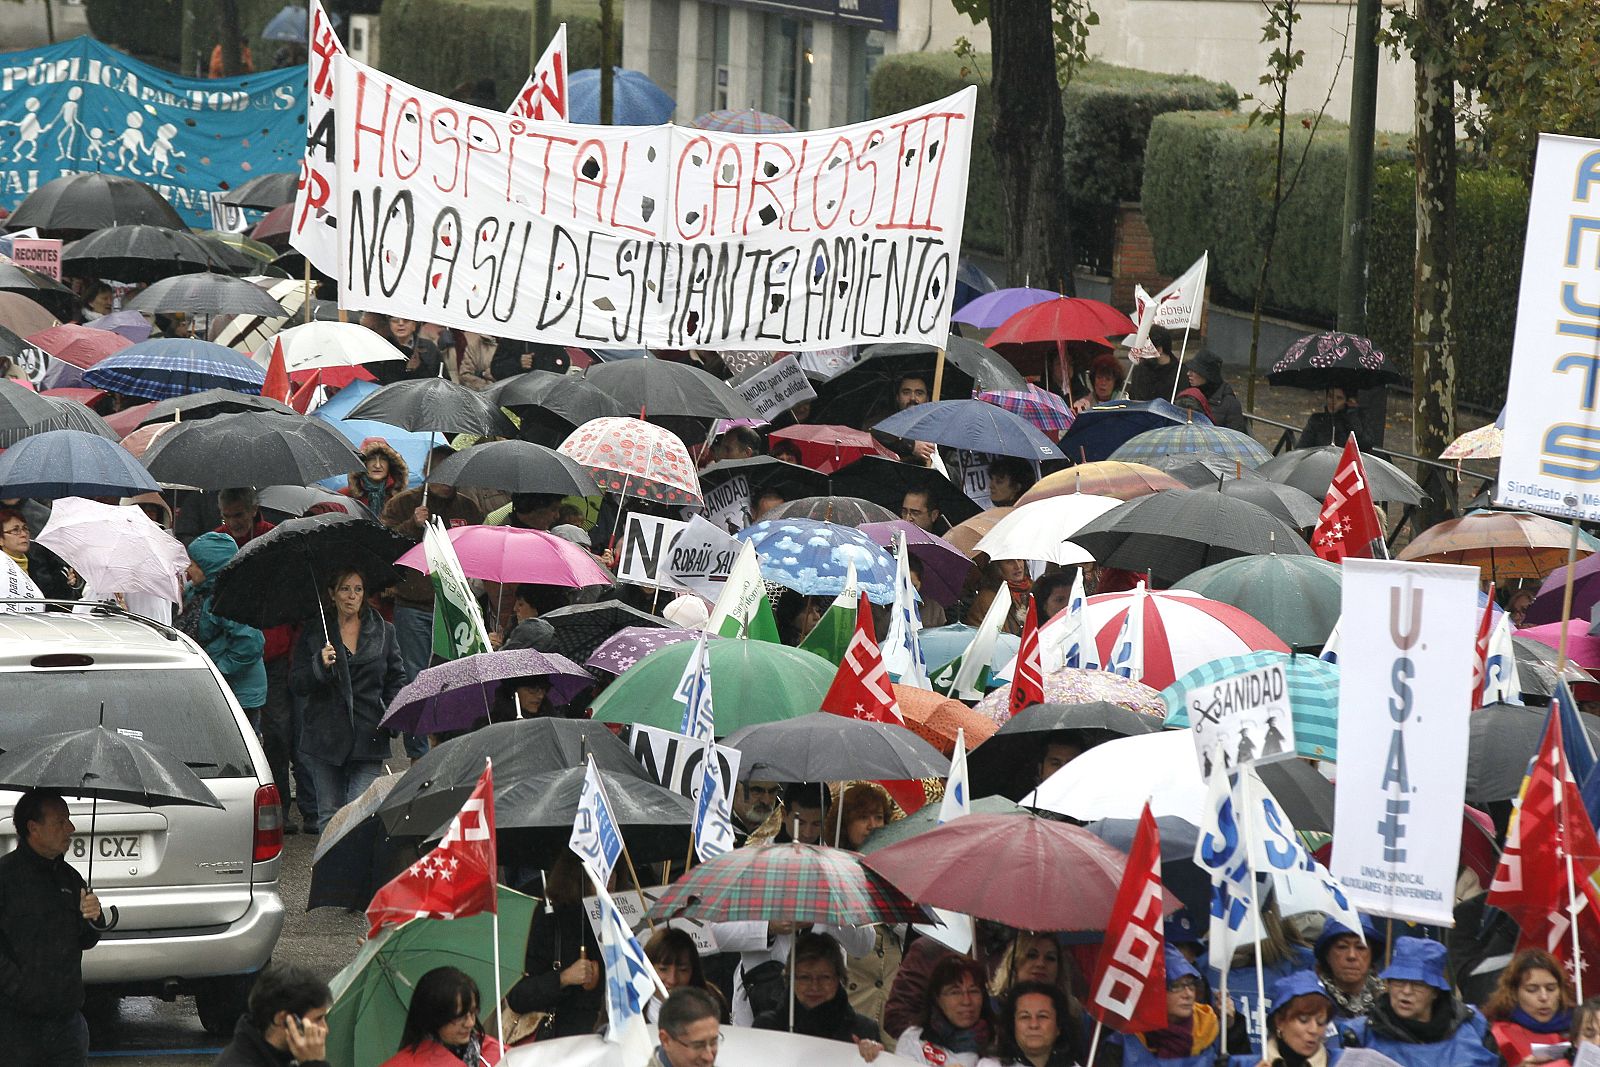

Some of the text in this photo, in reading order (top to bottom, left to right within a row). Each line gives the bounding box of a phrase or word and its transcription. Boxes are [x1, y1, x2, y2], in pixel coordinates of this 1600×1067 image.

[675, 130, 884, 240] CARLOS
[876, 112, 965, 232] III
[15, 248, 58, 262] RECORTES
[349, 186, 414, 297] NO
[423, 207, 462, 308] A
[467, 217, 531, 322] SU
[741, 381, 769, 402] ANIDAD:
[700, 477, 748, 518] SANIDAD
[1507, 480, 1561, 501] Sindicato
[1517, 498, 1585, 518] Comunidad
[1213, 666, 1283, 719] SANIDAD
[100, 837, 139, 857] CXZ
